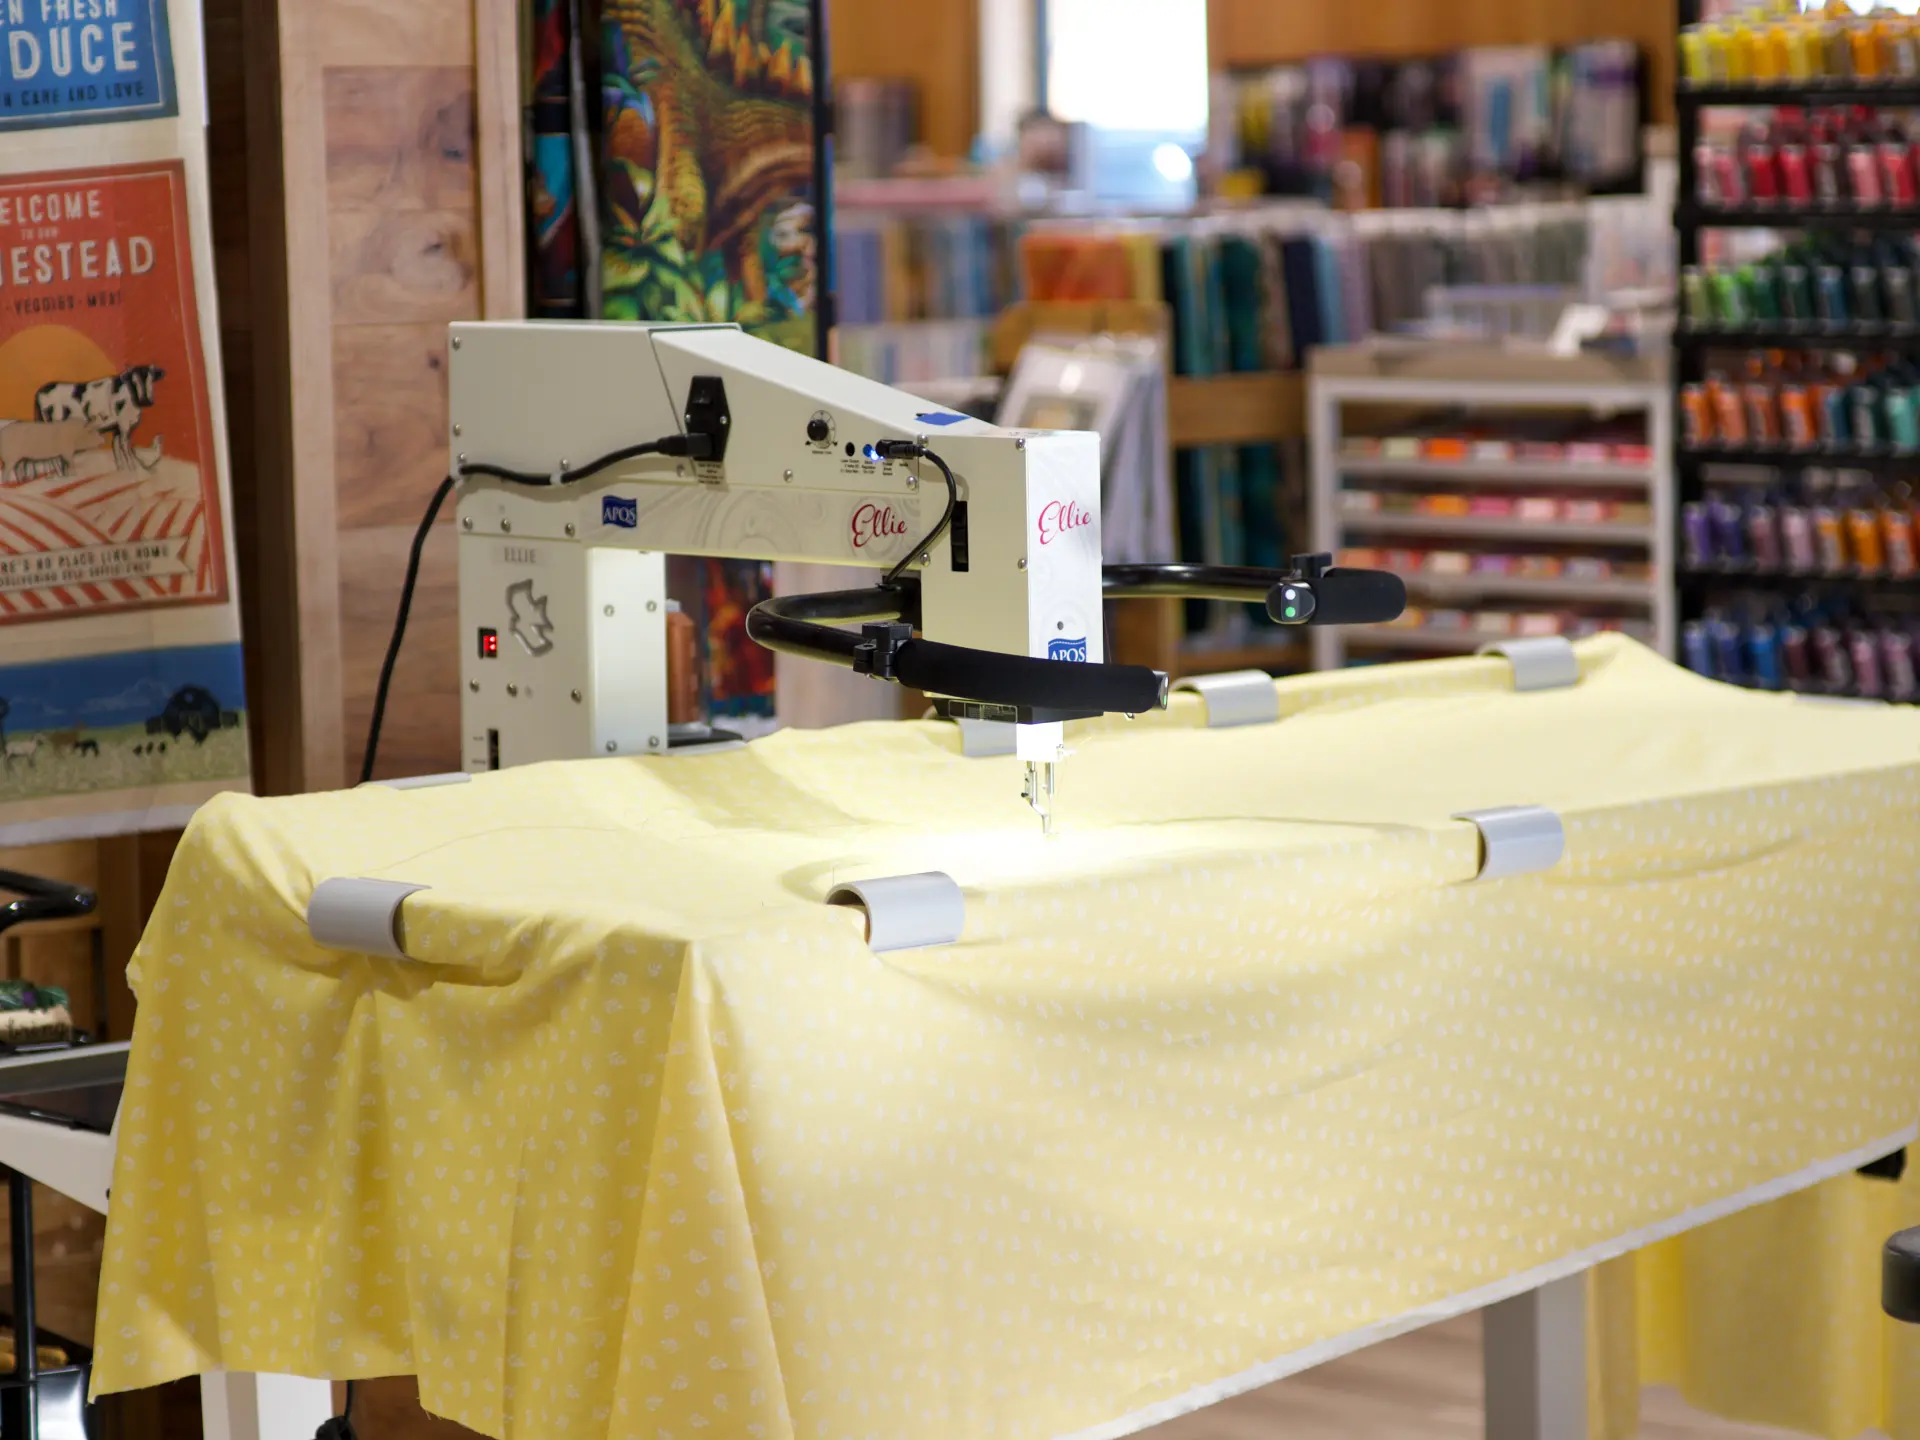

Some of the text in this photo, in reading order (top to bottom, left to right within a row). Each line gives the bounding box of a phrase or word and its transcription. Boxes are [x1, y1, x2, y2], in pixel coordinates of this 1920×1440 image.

[41, 0, 117, 24] FRESH
[8, 21, 138, 80] DUCE
[21, 87, 60, 107] CARE
[68, 84, 98, 103] AND
[105, 81, 145, 101] LOVE
[0, 236, 155, 287] ESTEAD
[852, 503, 908, 548] Ellie
[1038, 500, 1092, 545] Ellie
[503, 546, 537, 564] ELLIE
